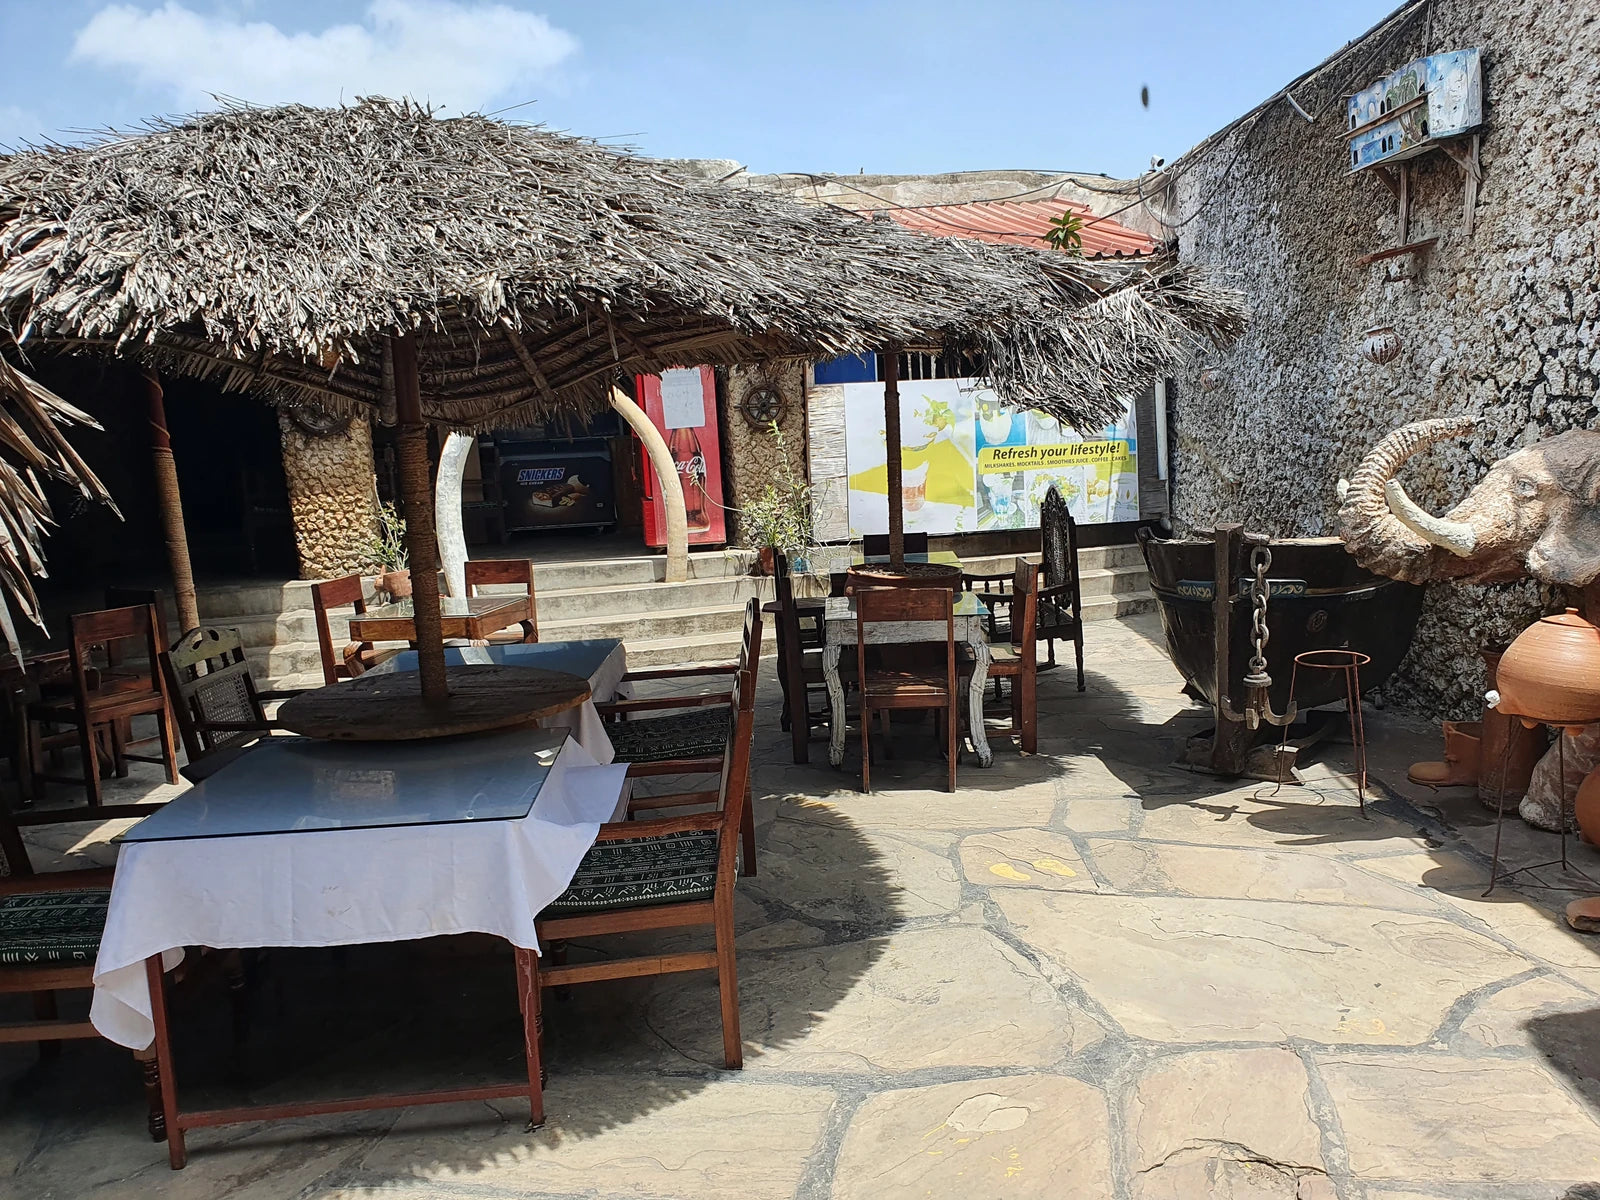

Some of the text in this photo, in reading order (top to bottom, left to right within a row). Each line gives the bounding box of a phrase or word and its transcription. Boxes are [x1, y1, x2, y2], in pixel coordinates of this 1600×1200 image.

[992, 442, 1121, 460] Refresh your lifestyle!
[518, 468, 564, 481] SNICKERS
